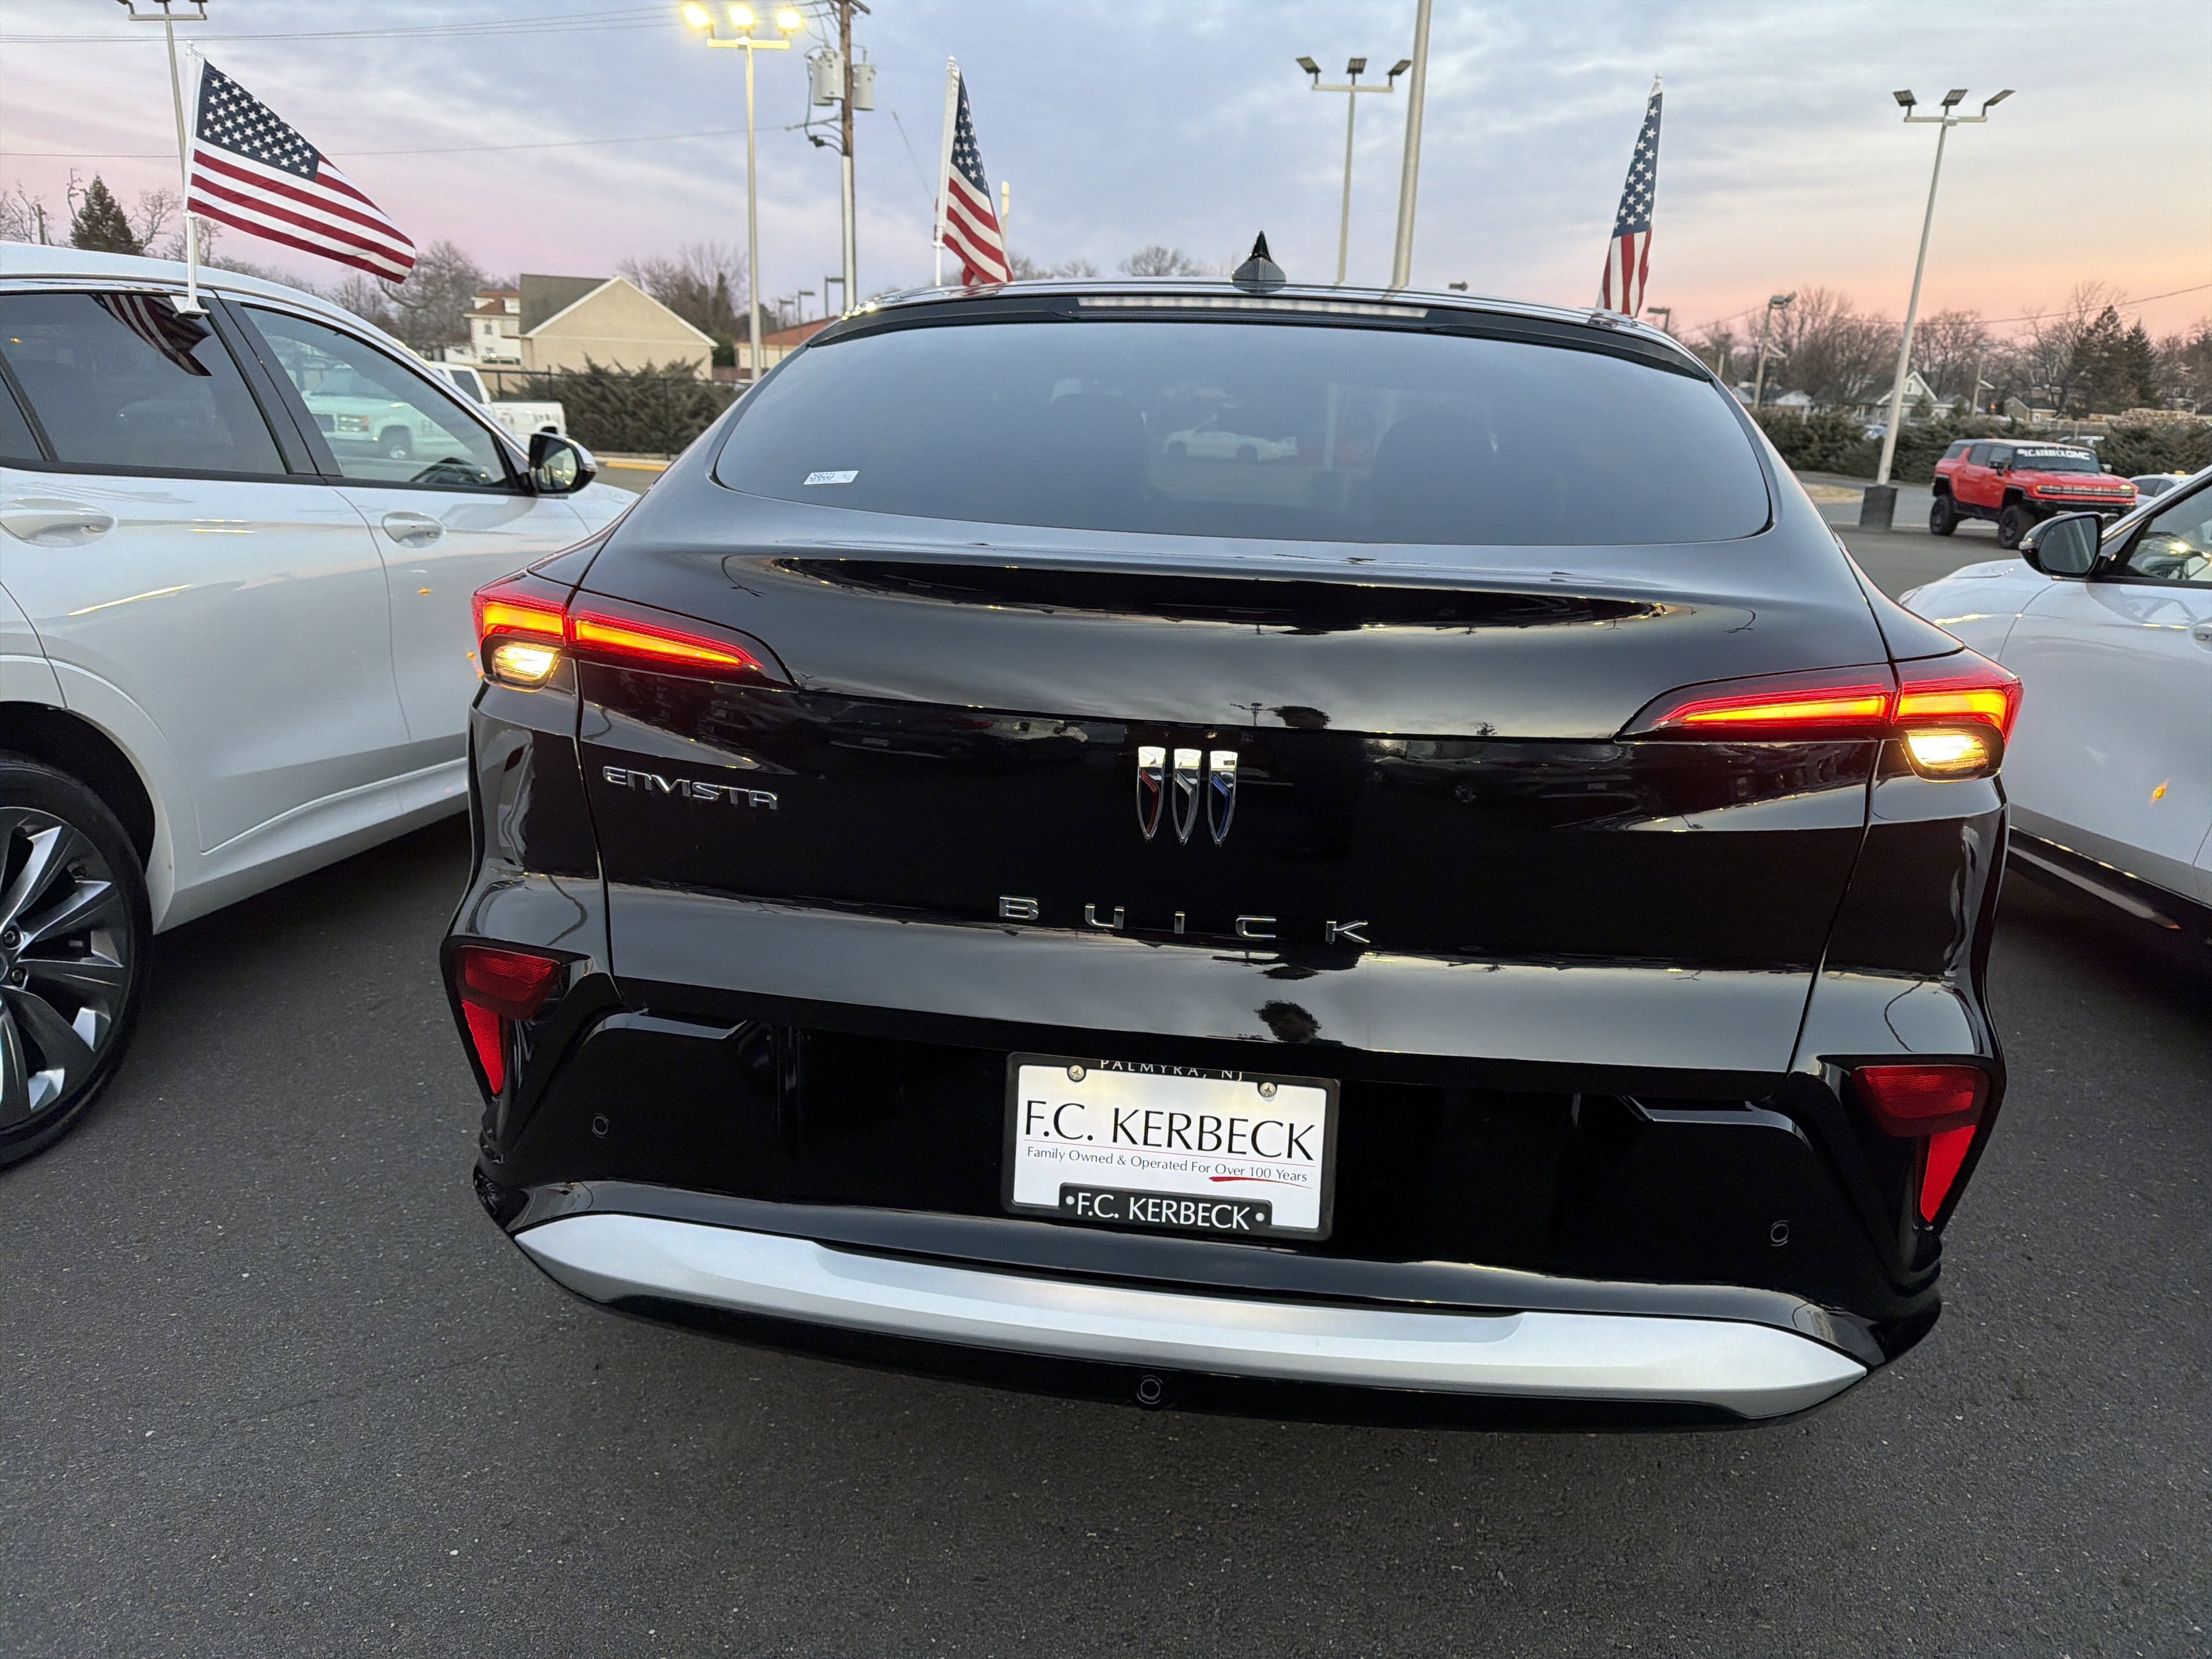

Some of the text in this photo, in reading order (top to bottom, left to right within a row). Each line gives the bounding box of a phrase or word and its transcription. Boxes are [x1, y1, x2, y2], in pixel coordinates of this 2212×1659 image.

[602, 765, 778, 810] ENVISTA
[999, 894, 1371, 944] BUICK
[1025, 1100, 1316, 1161] F.C. KERBECK
[1027, 1146, 1308, 1183] Family Owned & Operated For Over 100 Years
[1076, 1192, 1251, 1231] F.C. KERBECK
